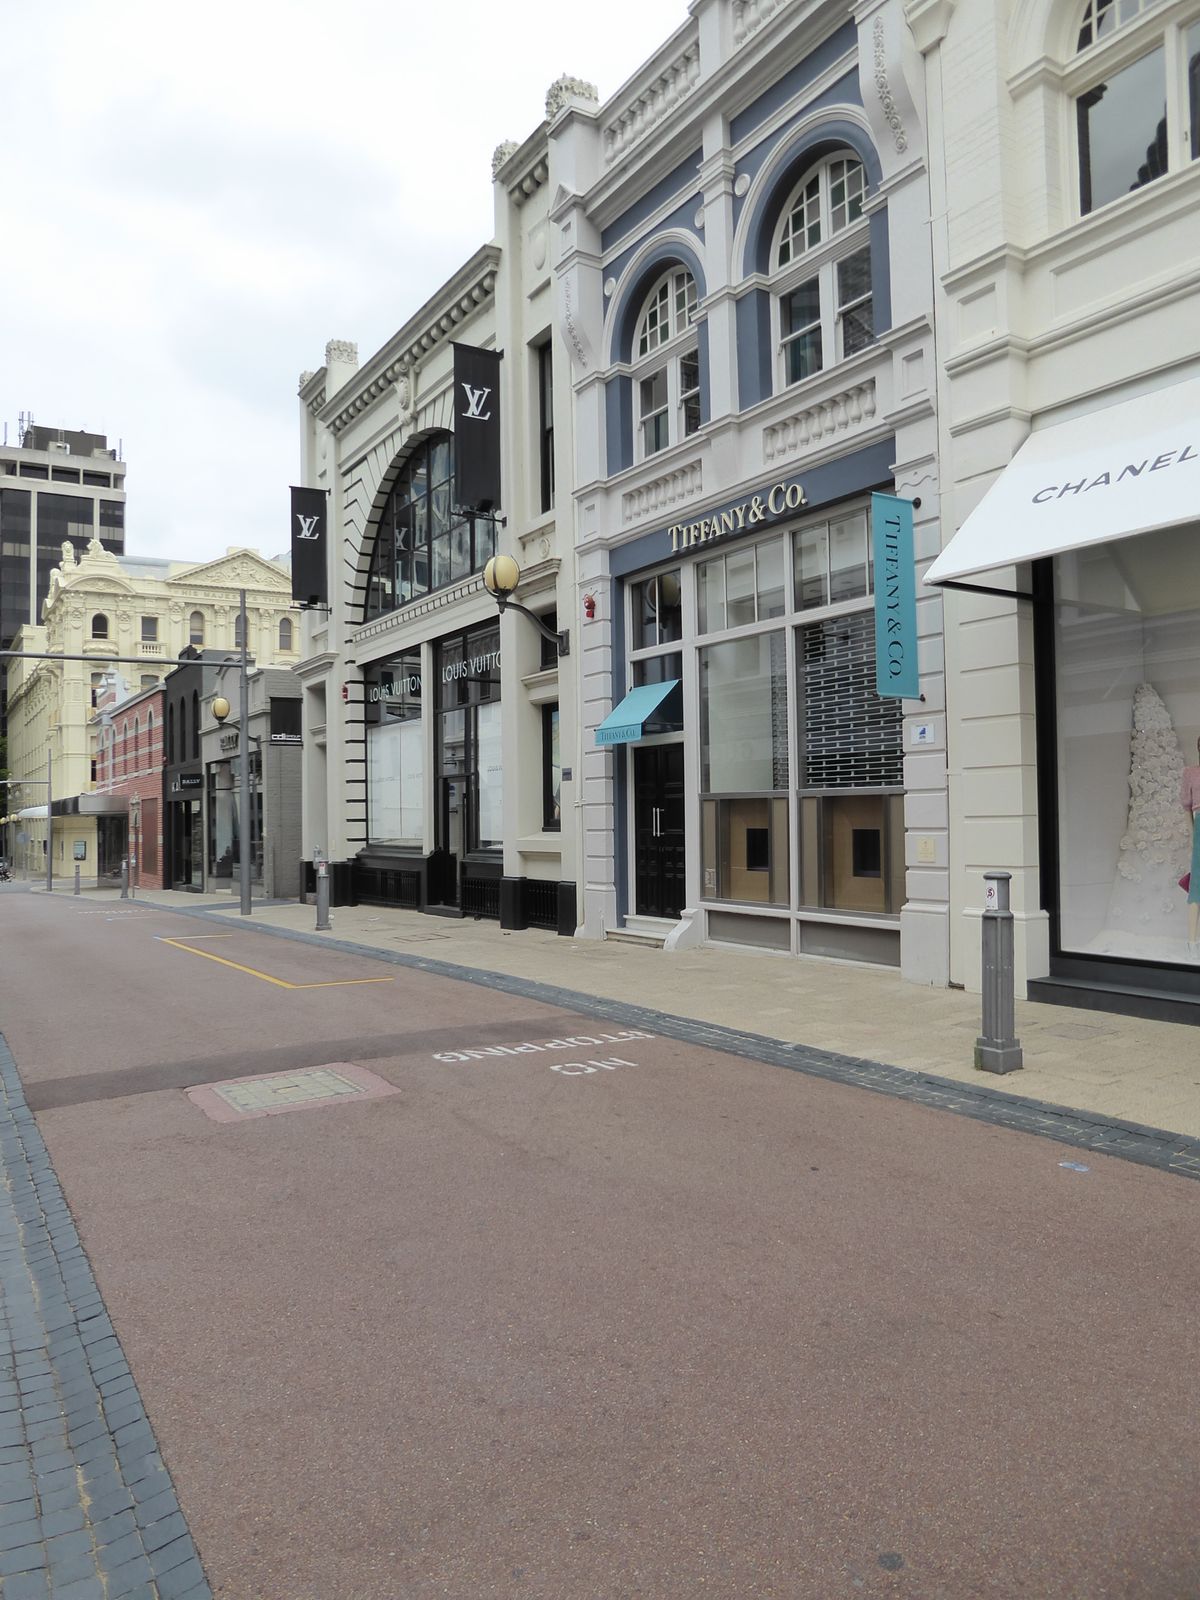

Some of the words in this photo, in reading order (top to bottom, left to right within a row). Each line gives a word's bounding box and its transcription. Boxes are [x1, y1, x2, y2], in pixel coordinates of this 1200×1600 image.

[1031, 444, 1199, 504] CHANEL
[442, 660, 468, 683] LOUIS
[470, 651, 501, 675] VUITTO
[432, 1030, 655, 1062] STOPPING
[550, 1057, 638, 1076] NO
